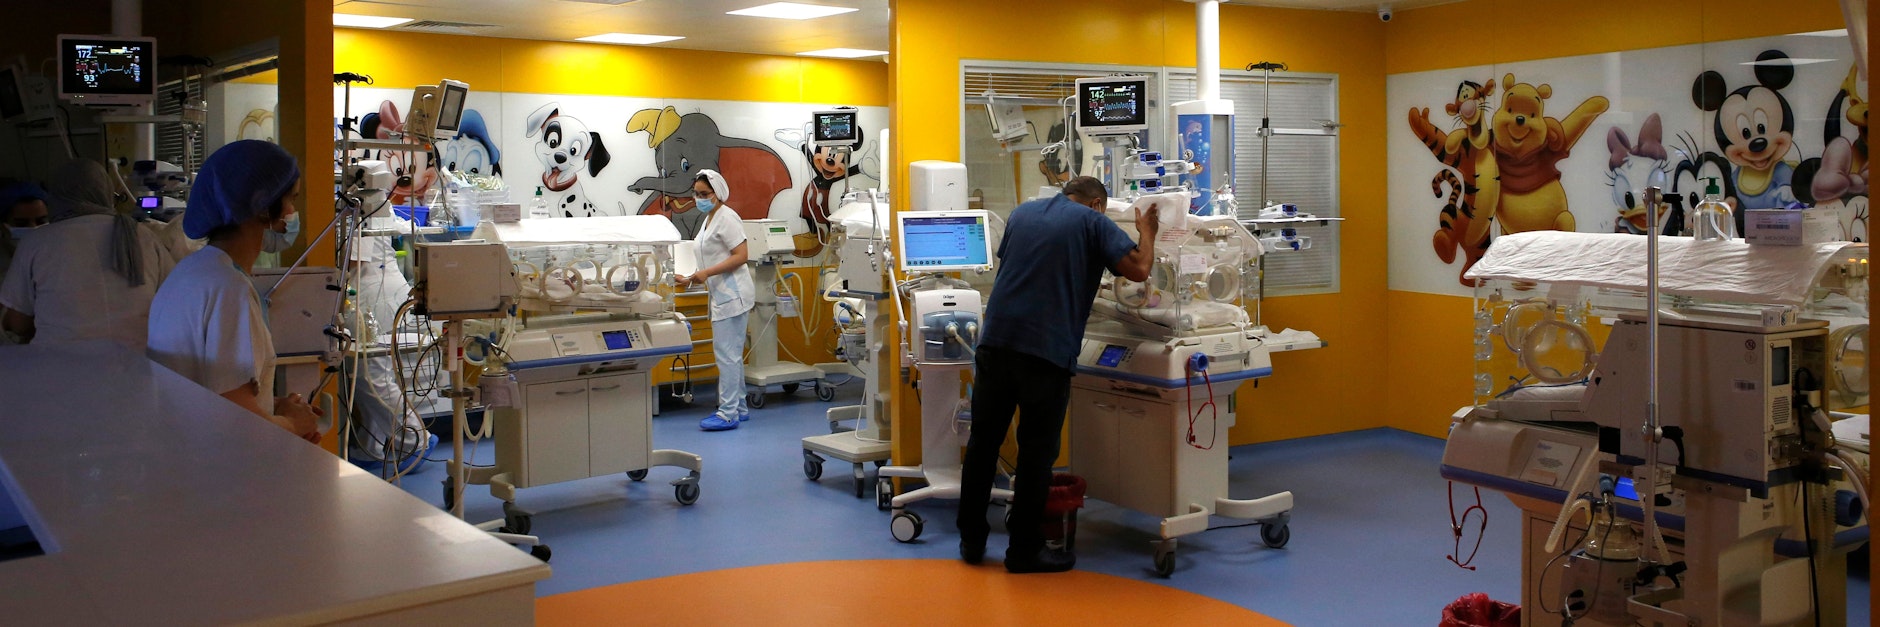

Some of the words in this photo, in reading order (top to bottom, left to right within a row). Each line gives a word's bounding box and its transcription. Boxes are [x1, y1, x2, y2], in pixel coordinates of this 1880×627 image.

[78, 50, 92, 59] 172
[83, 74, 95, 82] 93
[1091, 90, 1105, 99] 142
